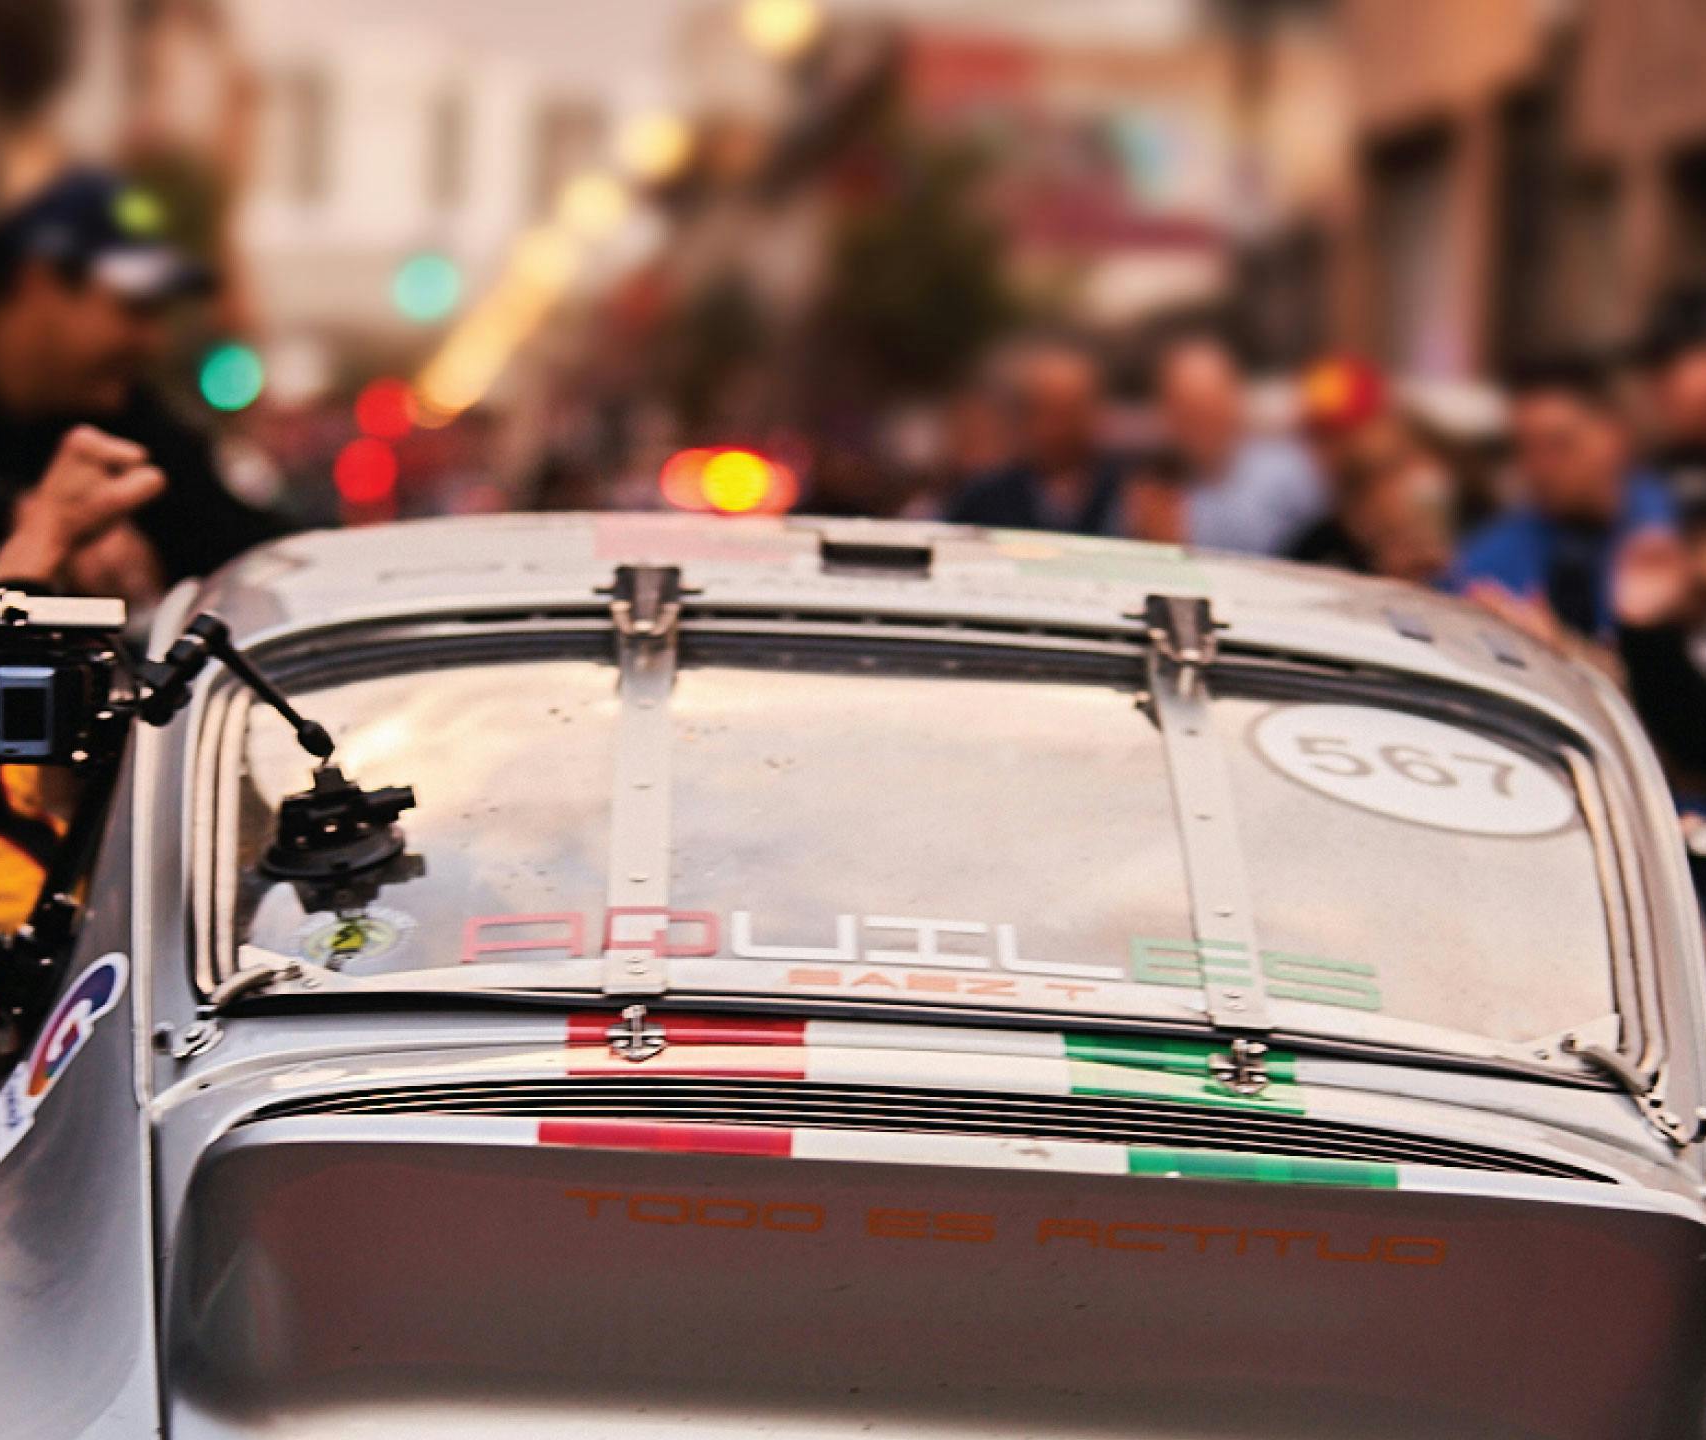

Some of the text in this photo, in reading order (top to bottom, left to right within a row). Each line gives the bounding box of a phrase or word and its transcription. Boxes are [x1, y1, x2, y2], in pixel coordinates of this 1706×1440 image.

[1295, 735, 1515, 798] 567
[460, 905, 1383, 1011] AQUILES
[564, 1188, 826, 1234] TODO
[865, 1206, 996, 1243] ES
